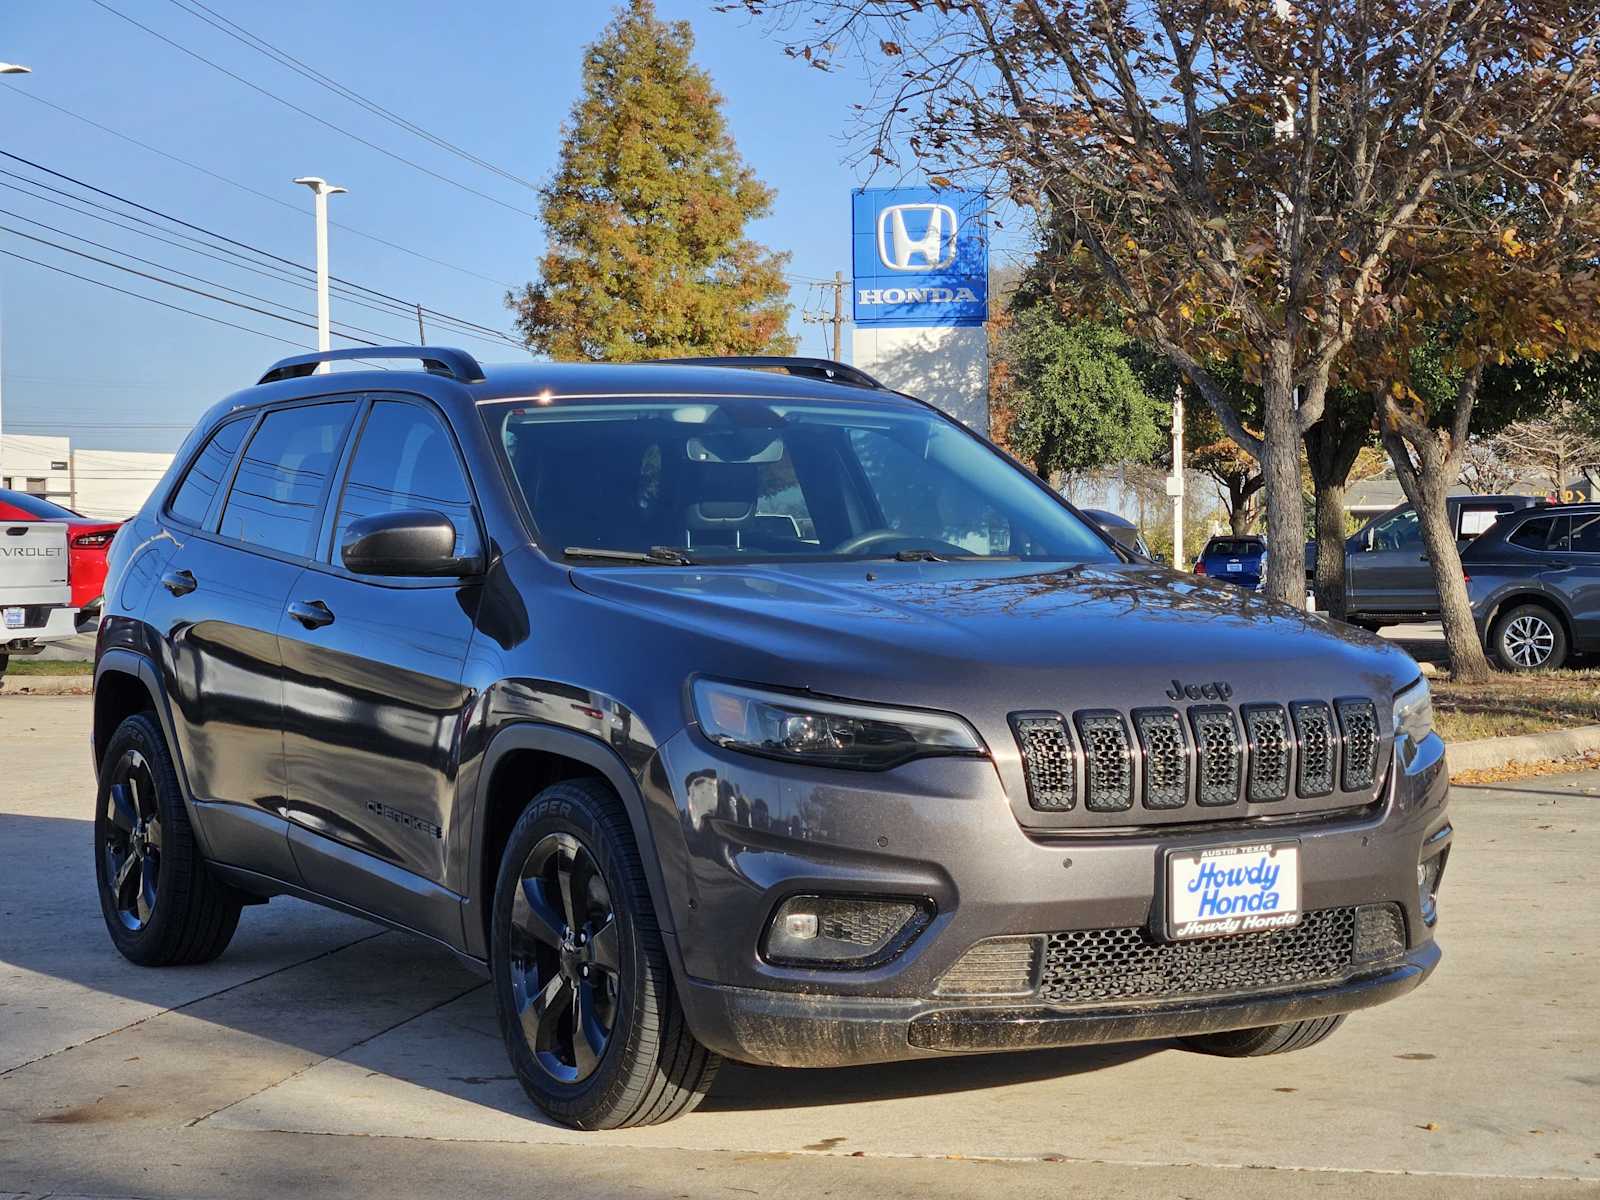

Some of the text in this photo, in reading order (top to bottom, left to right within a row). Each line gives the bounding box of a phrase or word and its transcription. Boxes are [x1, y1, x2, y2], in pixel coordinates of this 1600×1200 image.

[858, 287, 979, 305] HONDA
[0, 547, 63, 557] VROLET
[1166, 679, 1233, 702] Jeep
[1201, 844, 1273, 858] AUSTIN TEXAS
[1187, 857, 1280, 893] Howdy
[1198, 889, 1280, 917] Honda
[1177, 912, 1298, 936] Howdy Honda
